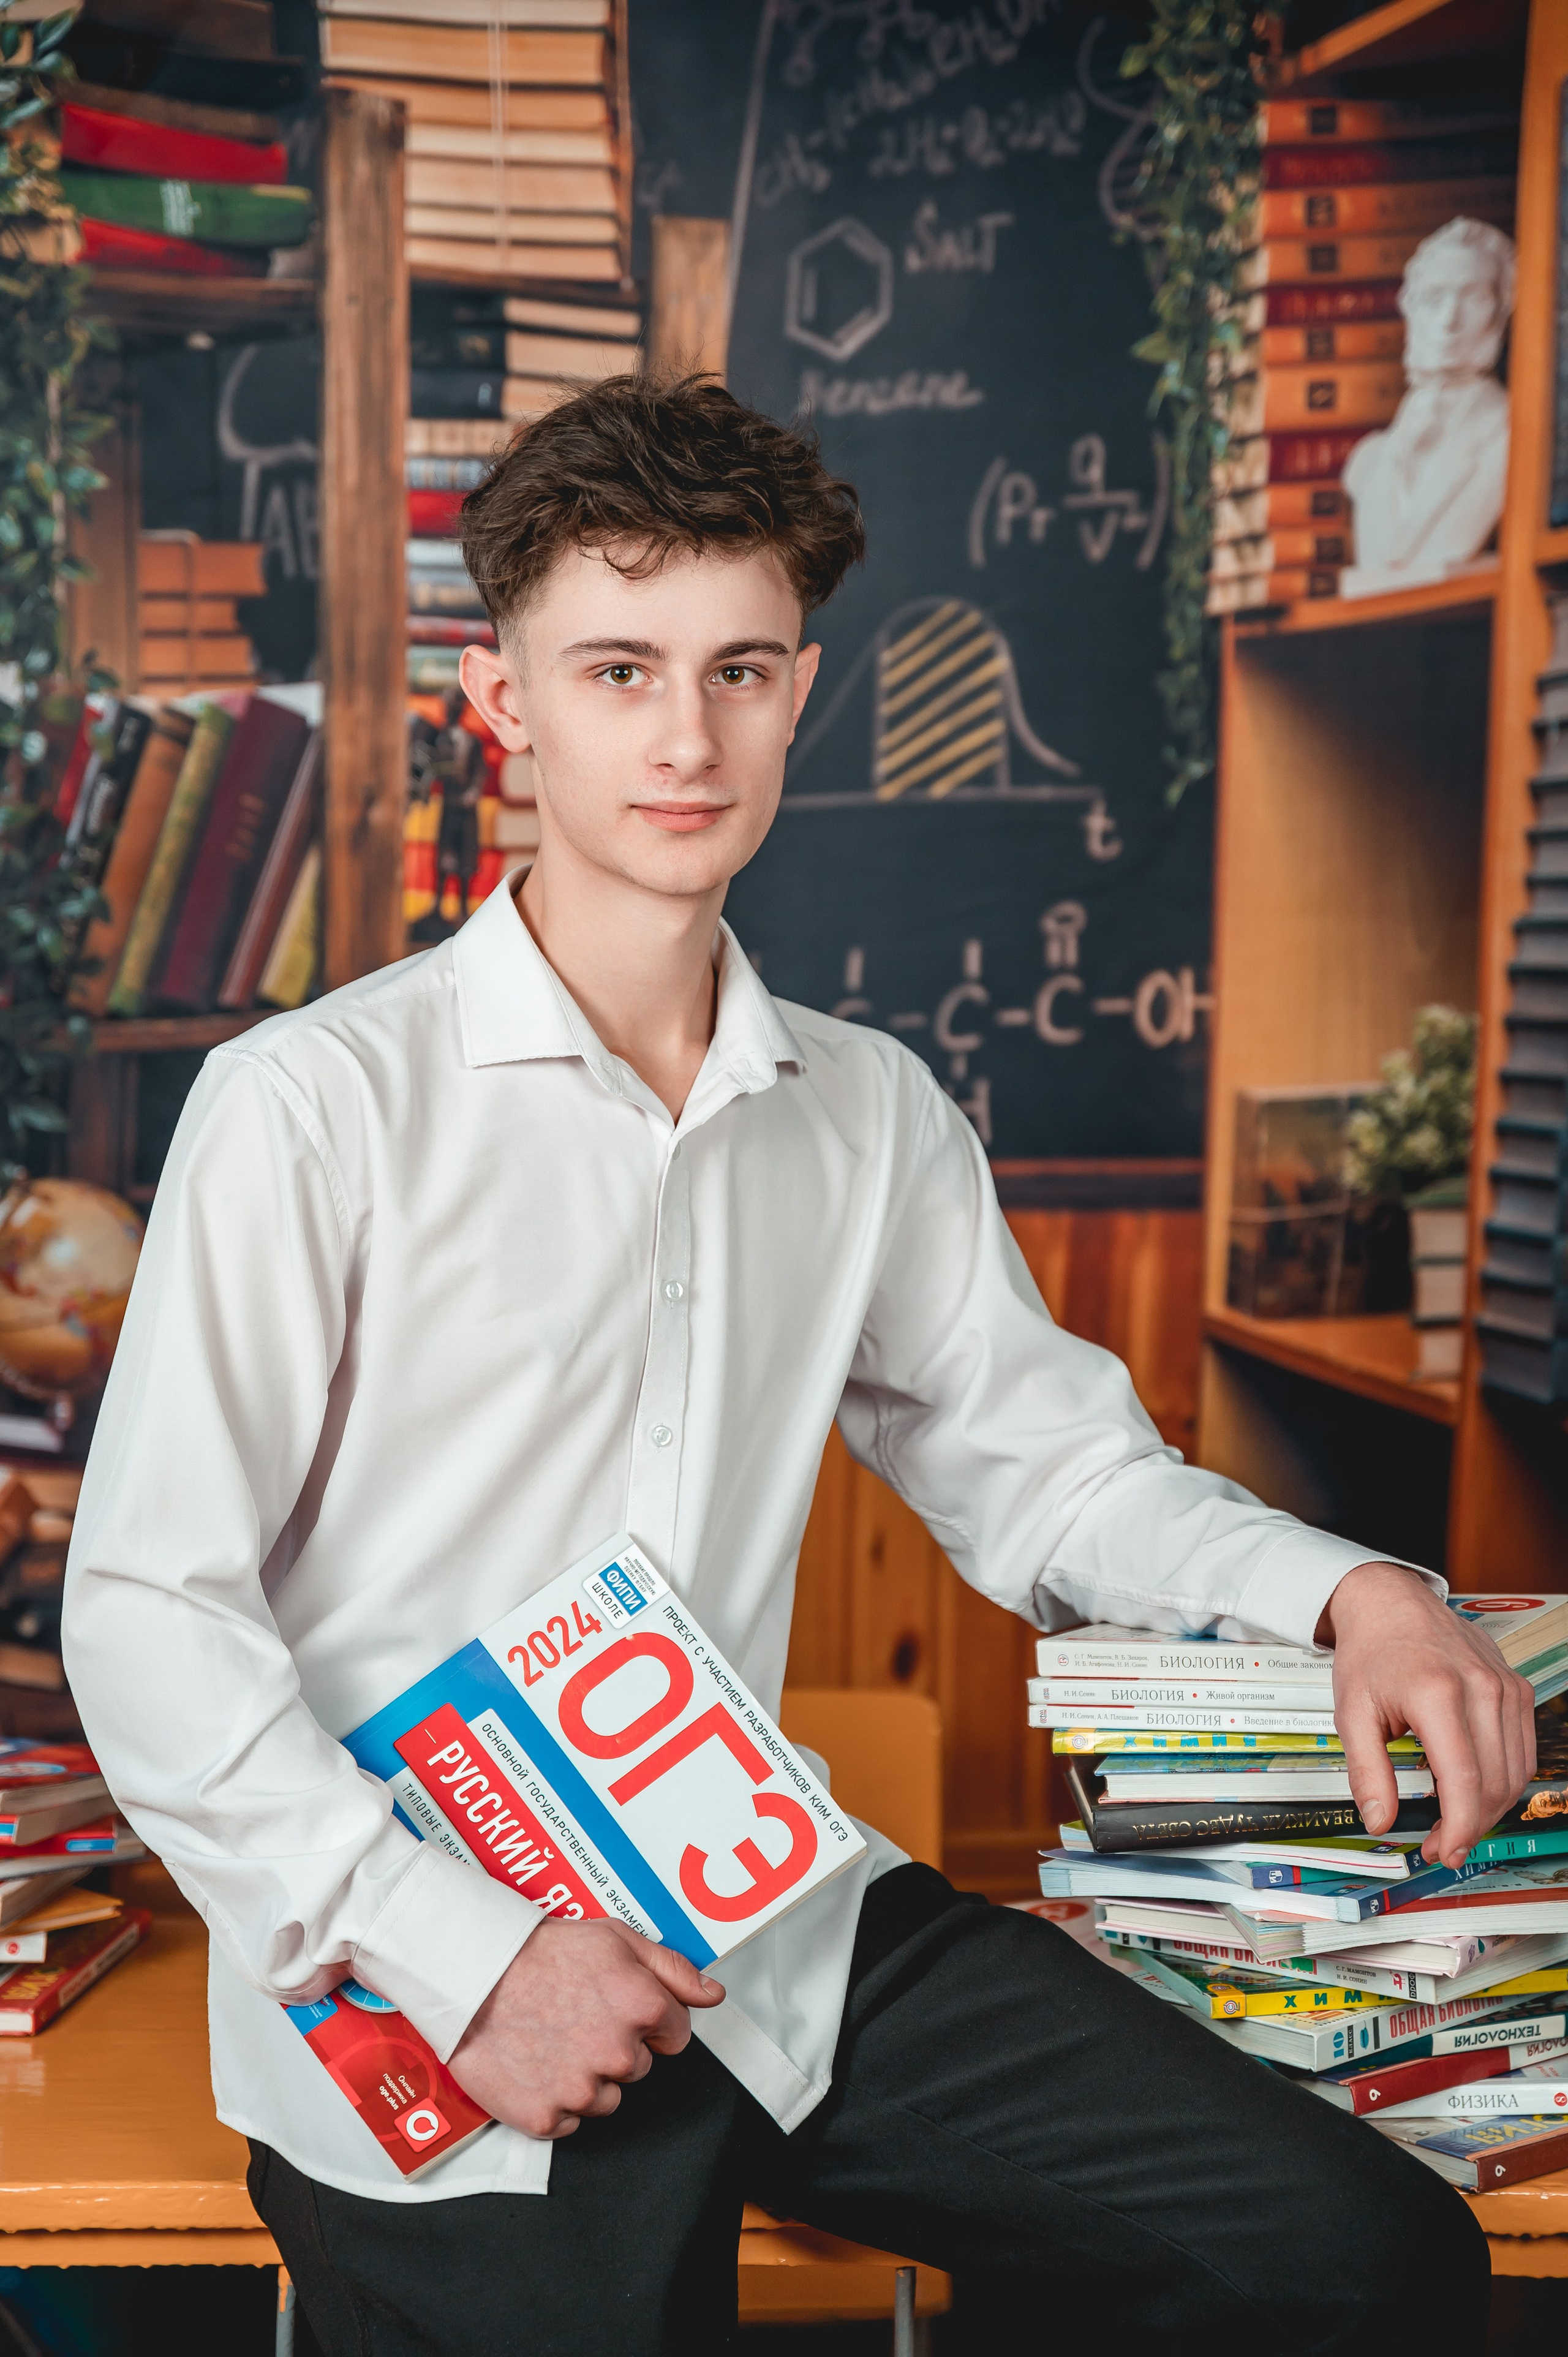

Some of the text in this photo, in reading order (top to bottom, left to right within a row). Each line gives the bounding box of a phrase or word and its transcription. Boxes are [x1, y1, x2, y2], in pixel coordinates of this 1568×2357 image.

[592, 1583, 623, 1618] ШКОЛЕ
[607, 1571, 641, 1610] ФИПИ
[508, 1601, 602, 1686] 2024
[1160, 1656, 1245, 1670] БИОЛОГИЯ
[1268, 1659, 1298, 1669] Общие
[1111, 1689, 1185, 1701] БИОЛОГИЯ
[1206, 1690, 1235, 1700] Живой
[1237, 1692, 1275, 1702] организм
[663, 1606, 697, 1644] ПРОЕКТ
[703, 1656, 746, 1710] УЧАСТИЕМ
[744, 1711, 810, 1793] РАЗРАБОТЧИКОВ
[809, 1795, 831, 1820] КИМ
[830, 1822, 848, 1841] ОГЭ
[1146, 1713, 1222, 1726] БИОЛОГИЯ
[1245, 1717, 1284, 1725] Введение
[1292, 1718, 1334, 1727] биологию
[1123, 1733, 1257, 1748] ХИМИЯ
[559, 1632, 817, 1922] ОГЭ
[403, 1783, 442, 1832] ТИПОВЫЕ
[427, 1740, 554, 1885] РУССКИЙ
[483, 1724, 529, 1780] ОСНОВНОЙ
[526, 1782, 609, 1887] ГОСУДАРСТВЕННЫЙ
[1132, 1820, 1193, 1840] СВЕТА
[1196, 1814, 1259, 1835] ЧУДЕС
[1263, 1809, 1354, 1831] ВЕЛИКИХ
[1390, 2004, 1435, 2038] ОБЩАЯ
[1455, 2023, 1542, 2048] ТЕХНОЛОГИЯ
[380, 2086, 399, 2110] oge.plus
[383, 2073, 407, 2104] поддержка
[399, 2076, 416, 2098] Онлайн
[1447, 2094, 1519, 2109] ФИЗИКА
